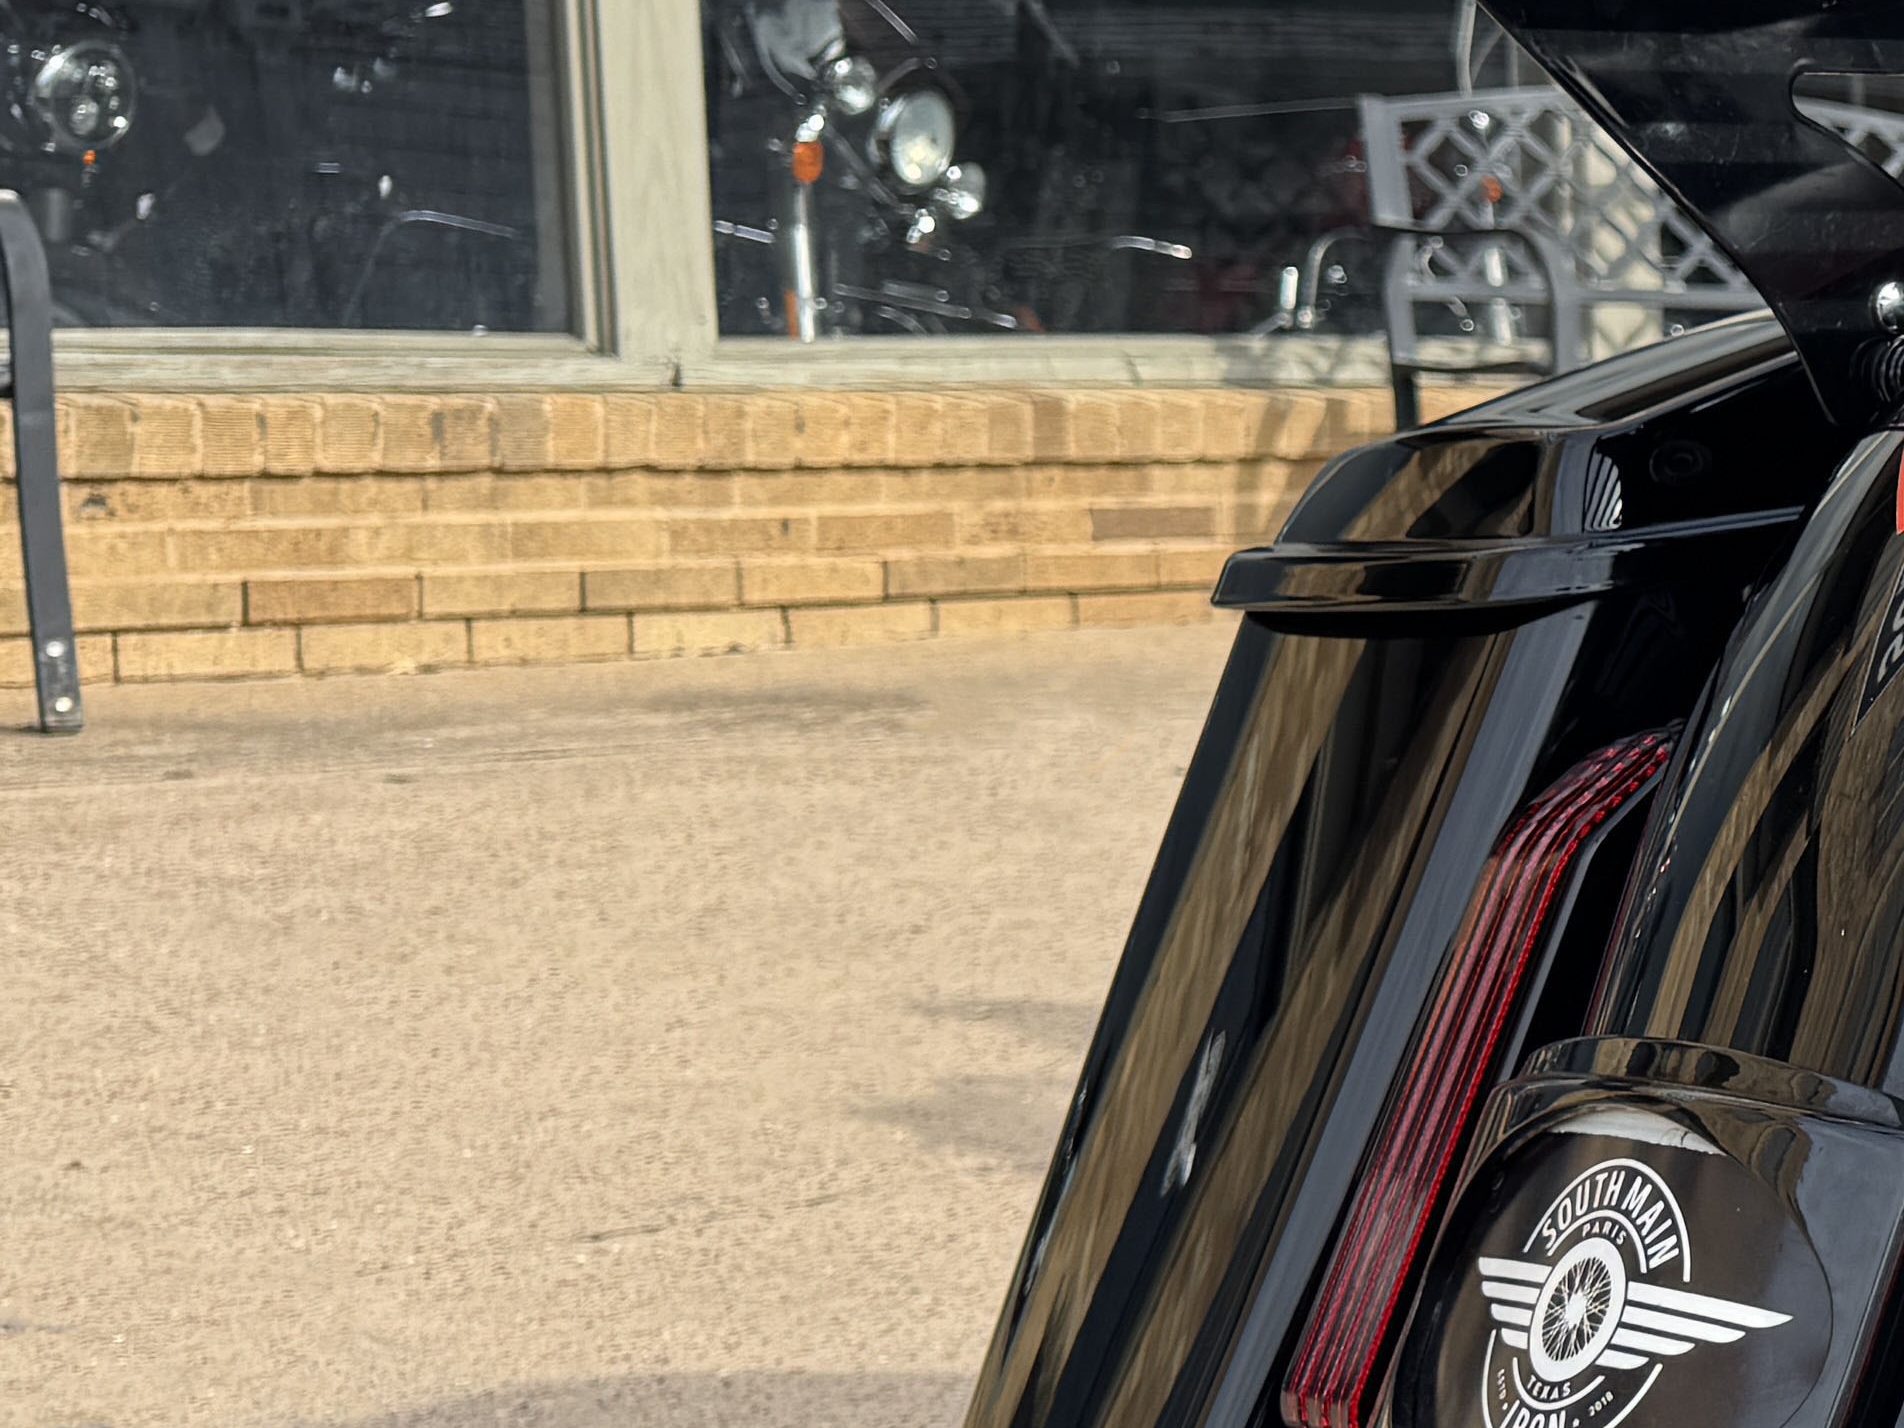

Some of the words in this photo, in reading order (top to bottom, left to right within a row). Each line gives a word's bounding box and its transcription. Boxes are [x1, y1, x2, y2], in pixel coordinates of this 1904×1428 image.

[1542, 1170, 1626, 1246] SOUTH
[1623, 1178, 1681, 1270] MAIN
[1582, 1223, 1627, 1246] PARIS
[1526, 1374, 1571, 1400] TEXAS
